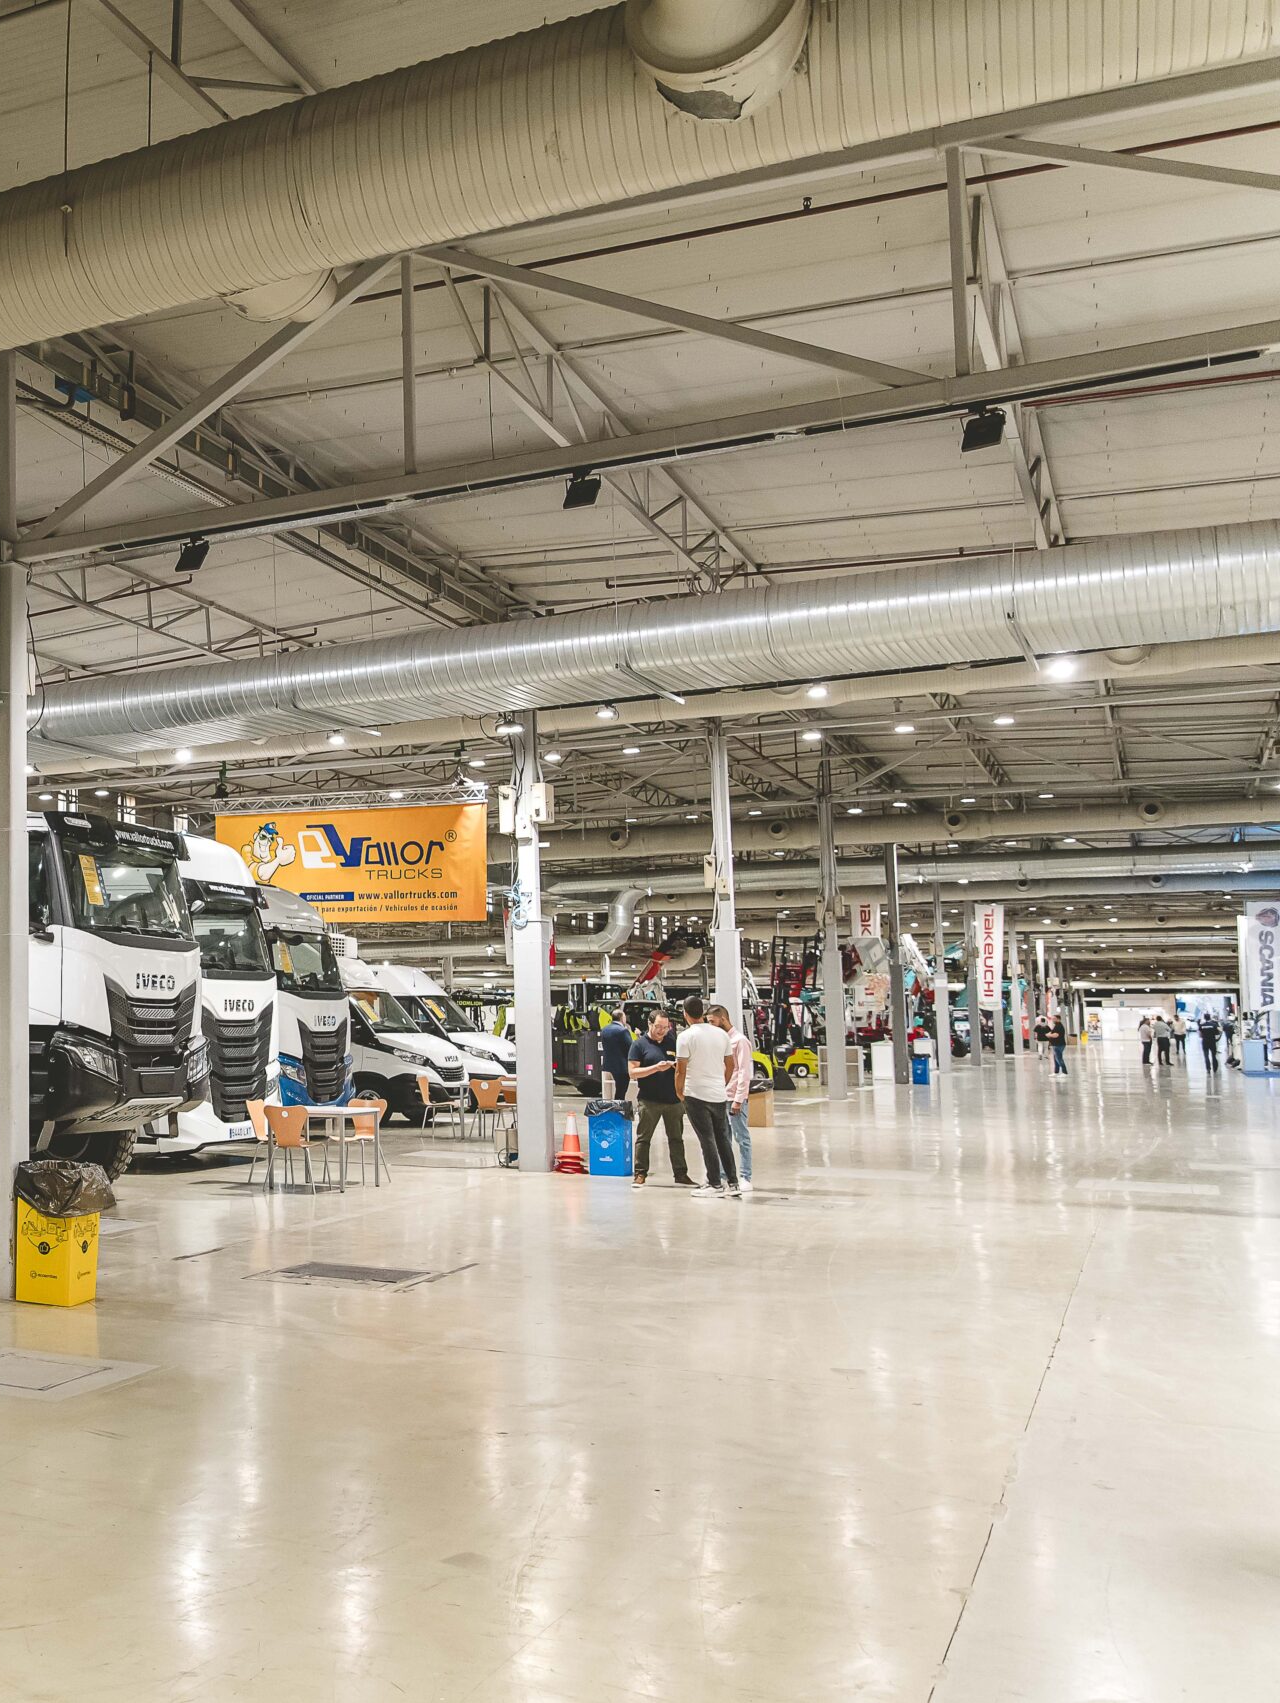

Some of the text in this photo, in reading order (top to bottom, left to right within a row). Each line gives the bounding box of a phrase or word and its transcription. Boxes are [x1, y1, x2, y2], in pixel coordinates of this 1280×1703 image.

[365, 868, 443, 880] TRUCKS
[358, 889, 458, 900] www.vallortrucks.com
[337, 904, 377, 913] exportación
[431, 903, 458, 911] ocasión
[1258, 930, 1275, 1007] SCANIA
[136, 973, 176, 990] IVECO
[224, 999, 255, 1012] IVECO
[314, 1015, 337, 1026] IVECO
